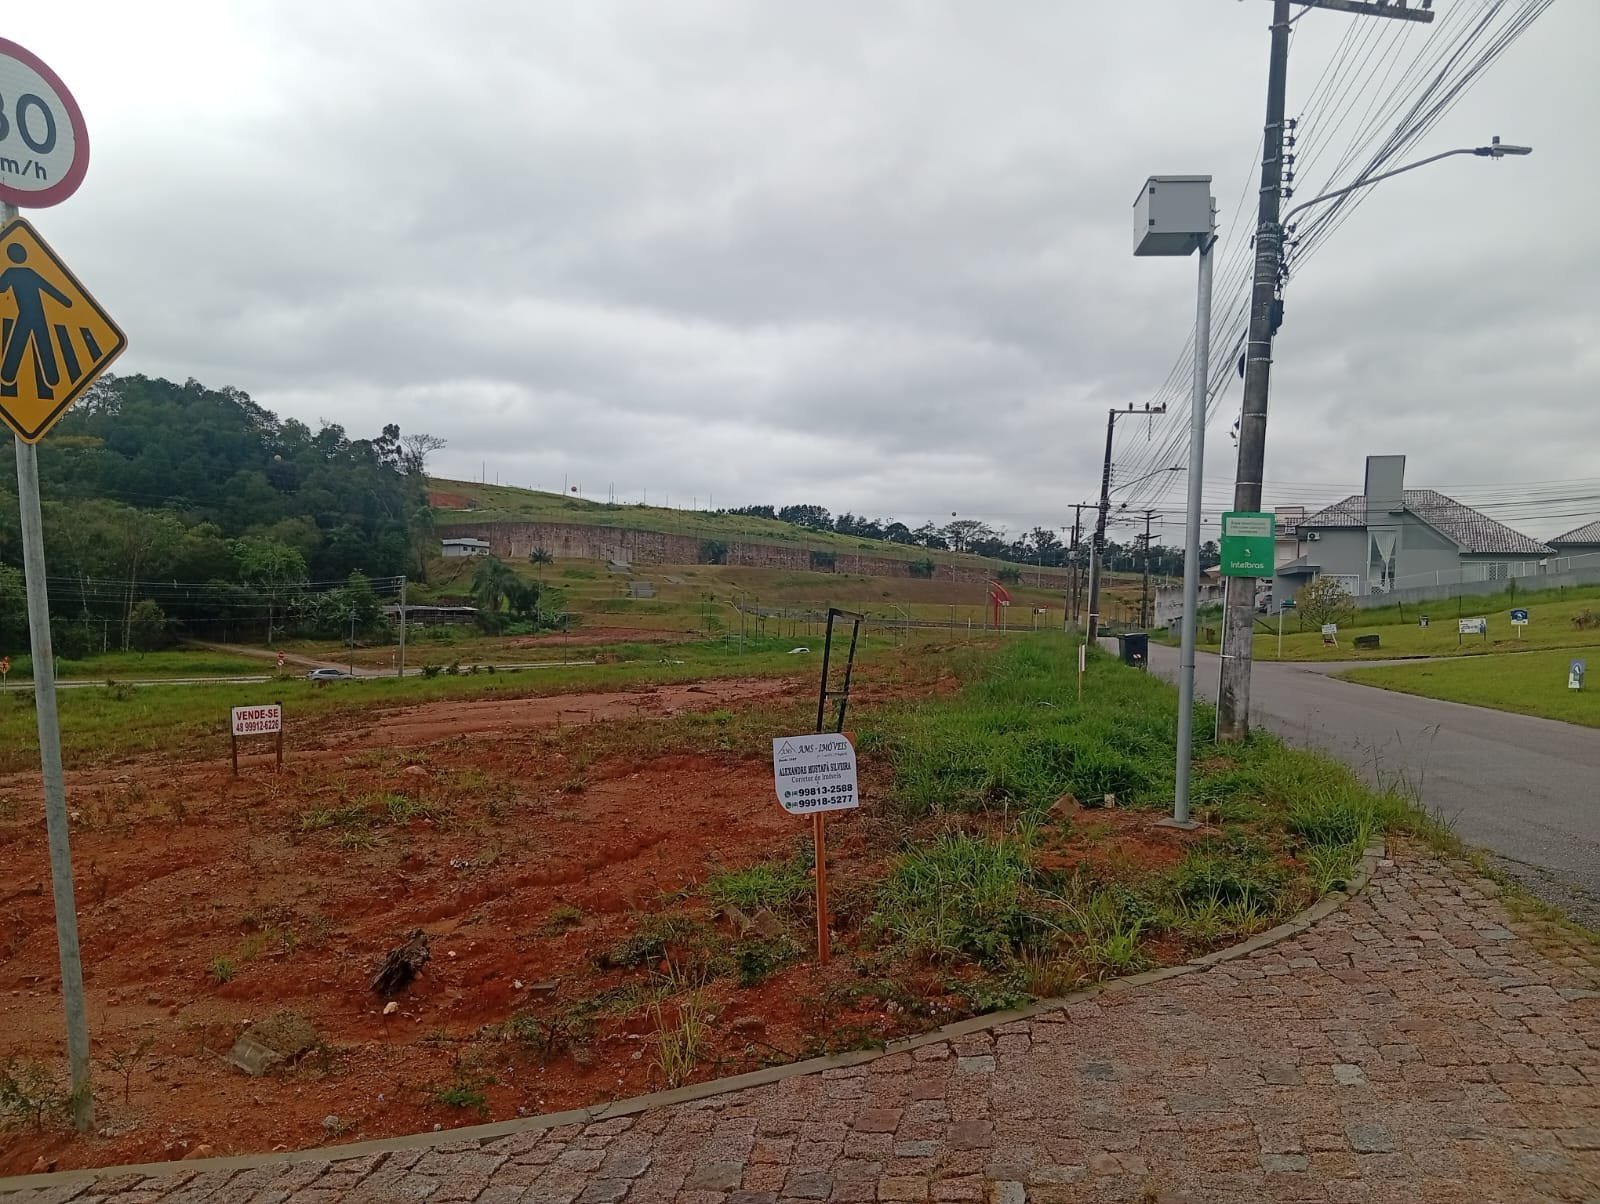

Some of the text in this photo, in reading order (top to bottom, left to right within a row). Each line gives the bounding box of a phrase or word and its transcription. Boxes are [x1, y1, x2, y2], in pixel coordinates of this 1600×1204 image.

[0, 90, 57, 154] 0
[0, 157, 47, 181] m/h
[236, 709, 278, 720] VENDE-SE
[236, 722, 243, 732] 48
[779, 765, 807, 776] ALEXANDRE
[830, 762, 851, 771] SILVEIRA
[791, 775, 813, 783] Corretor
[798, 784, 852, 797] 99813-2588
[799, 795, 852, 807] 99918-5277
